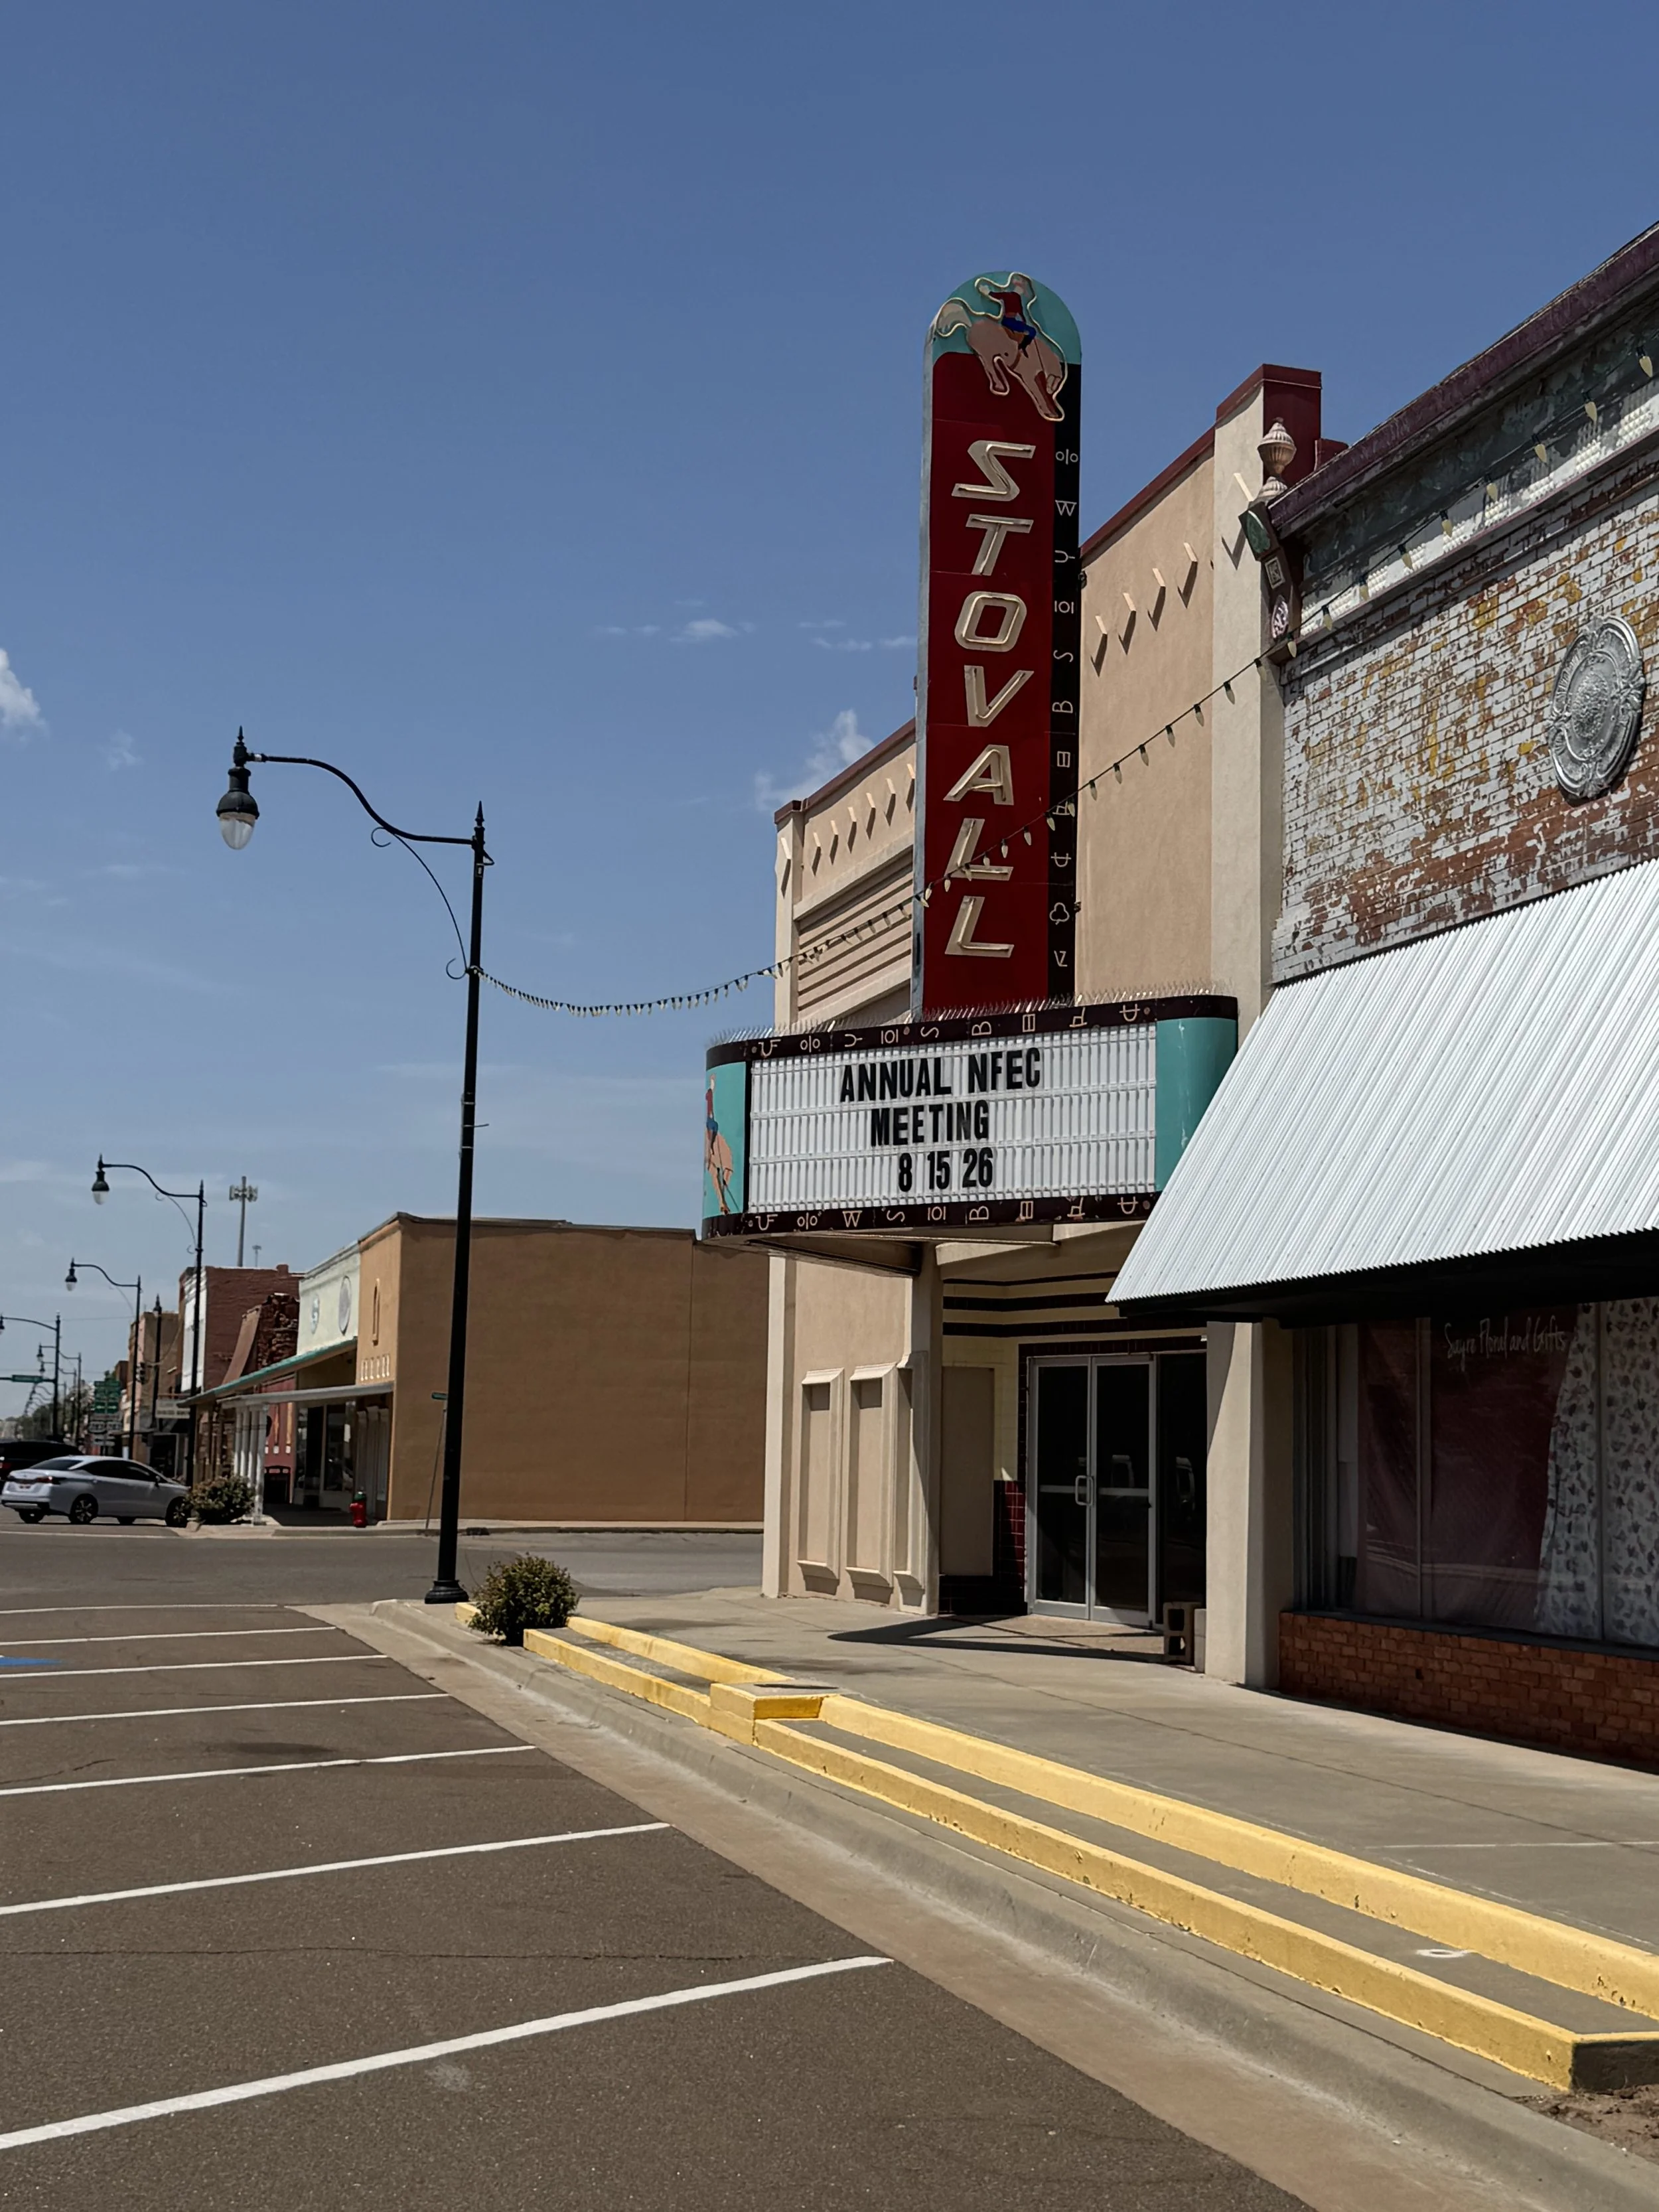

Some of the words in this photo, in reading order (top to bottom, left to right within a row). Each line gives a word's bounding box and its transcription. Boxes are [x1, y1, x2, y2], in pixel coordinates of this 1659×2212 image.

[943, 439, 1037, 958] STOVALL
[839, 1057, 952, 1102] ANNUAL
[968, 1047, 1041, 1094] NFEC
[870, 1099, 989, 1147] MEETING
[898, 1152, 912, 1192] 8
[927, 1149, 951, 1189] 15
[962, 1146, 993, 1187] 26
[1443, 1321, 1477, 1373] Sayre
[1479, 1317, 1509, 1360] Floral
[1510, 1315, 1532, 1356] and
[1533, 1315, 1568, 1353] Gifts
